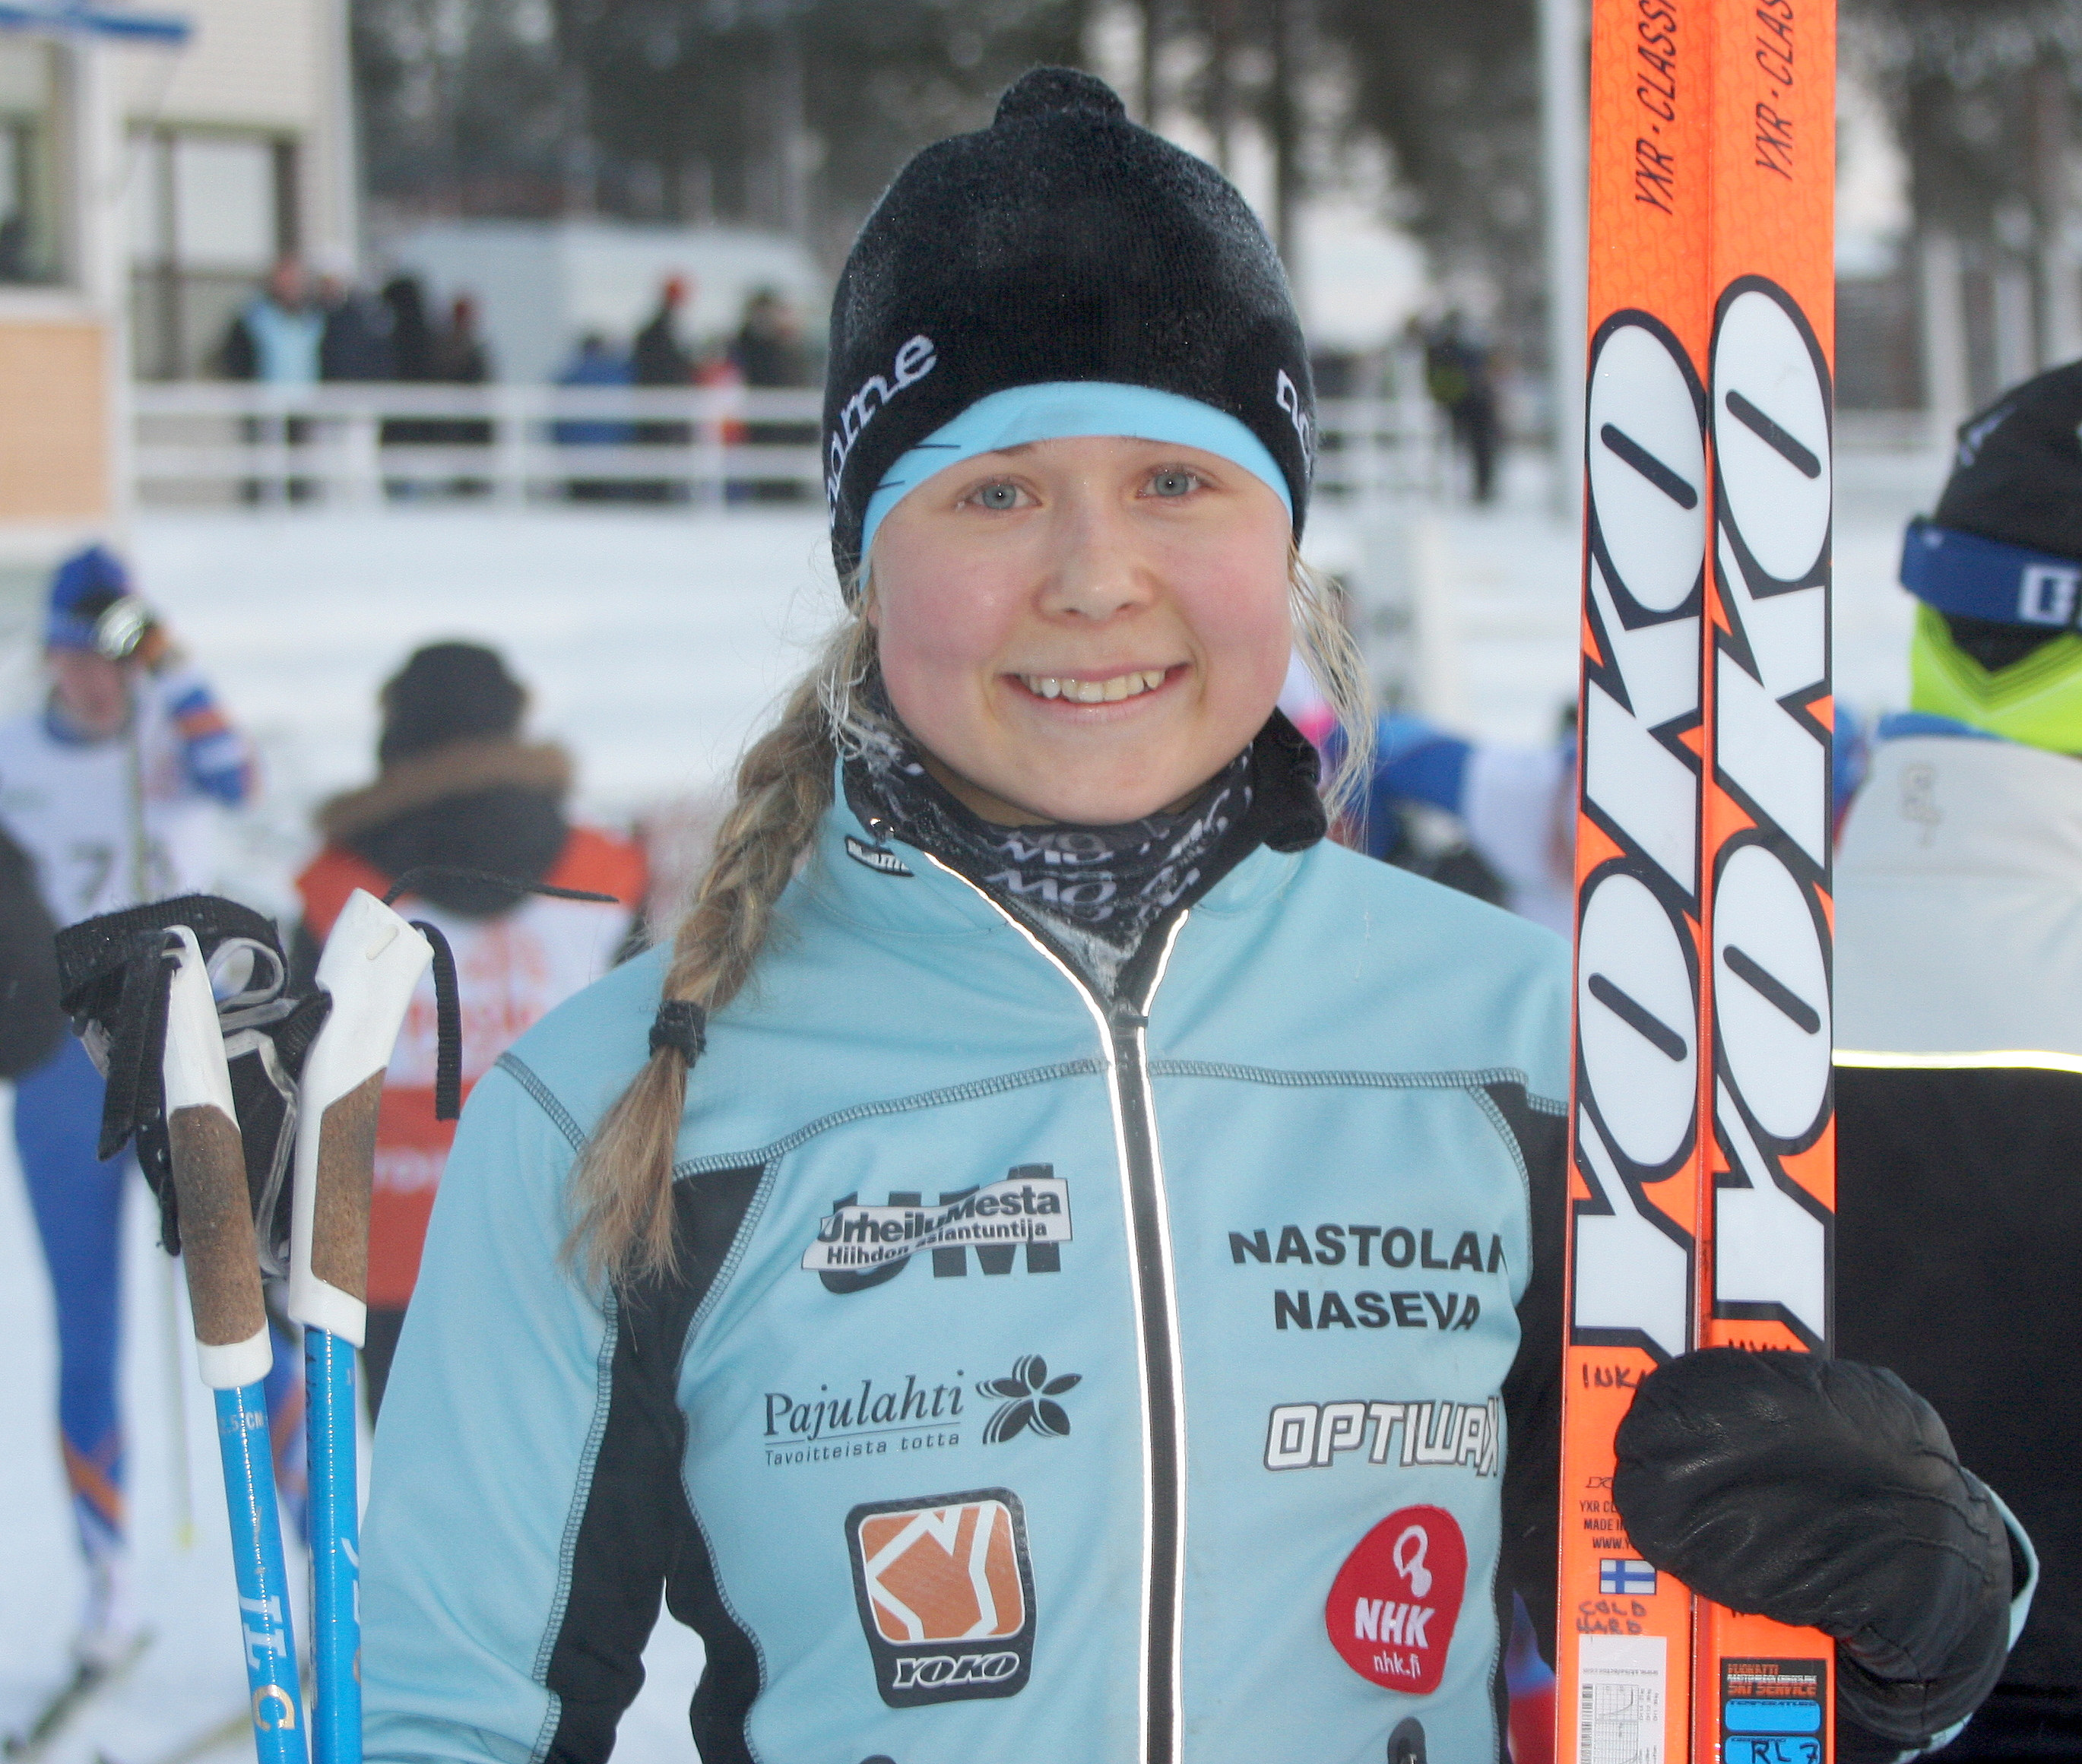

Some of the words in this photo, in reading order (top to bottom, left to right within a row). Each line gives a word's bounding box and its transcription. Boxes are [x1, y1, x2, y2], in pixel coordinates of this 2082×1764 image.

[1755, 102, 1793, 181] YXR
[1634, 138, 1675, 215] YXR
[1710, 274, 1833, 1345] YOKO
[1573, 309, 1707, 1359] YOKO
[1274, 1290, 1481, 1332] NASEVA
[764, 1369, 964, 1440] Pajulahti
[765, 1441, 888, 1467] Tavoitteista
[1263, 1396, 1500, 1477] OPTIWAX
[1580, 1500, 1600, 1512] YXR
[1603, 1500, 1619, 1513] CL
[1583, 1518, 1612, 1531] MADE
[1354, 1596, 1436, 1650] NHK
[1576, 1617, 1643, 1635] HARD
[1578, 1599, 1648, 1618] COLD
[892, 1651, 1022, 1690] YOKO
[1374, 1650, 1422, 1680] nhk.fi
[1727, 1682, 1754, 1697] SKI
[1755, 1682, 1817, 1697] SERVICE
